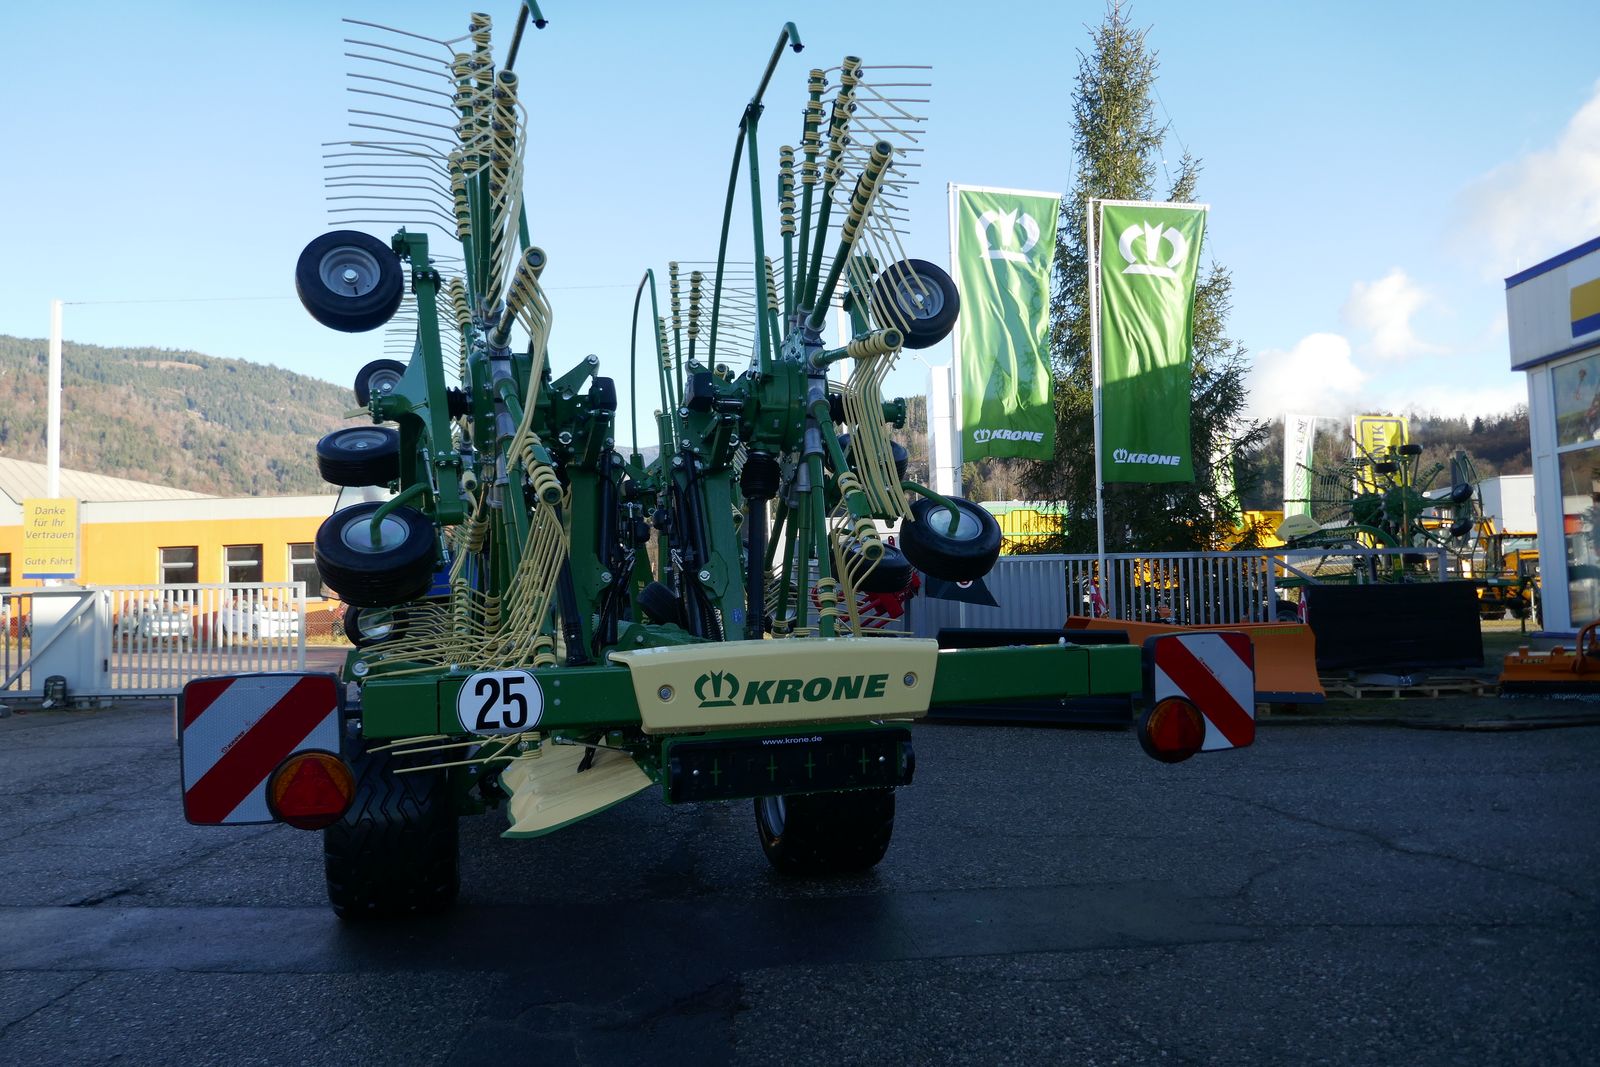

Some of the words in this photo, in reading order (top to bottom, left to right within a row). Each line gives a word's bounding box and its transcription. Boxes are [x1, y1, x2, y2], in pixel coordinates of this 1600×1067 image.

[990, 429, 1044, 442] KRONE
[1127, 453, 1181, 466] KRONE
[35, 507, 65, 515] Danke
[34, 518, 47, 527] für
[52, 519, 65, 527] Ihr
[26, 531, 74, 539] Vertrauen
[25, 557, 46, 565] Gute
[50, 557, 73, 565] Fahrt
[742, 673, 889, 706] KRONE
[474, 676, 528, 730] 25
[762, 735, 823, 746] www.krone.de
